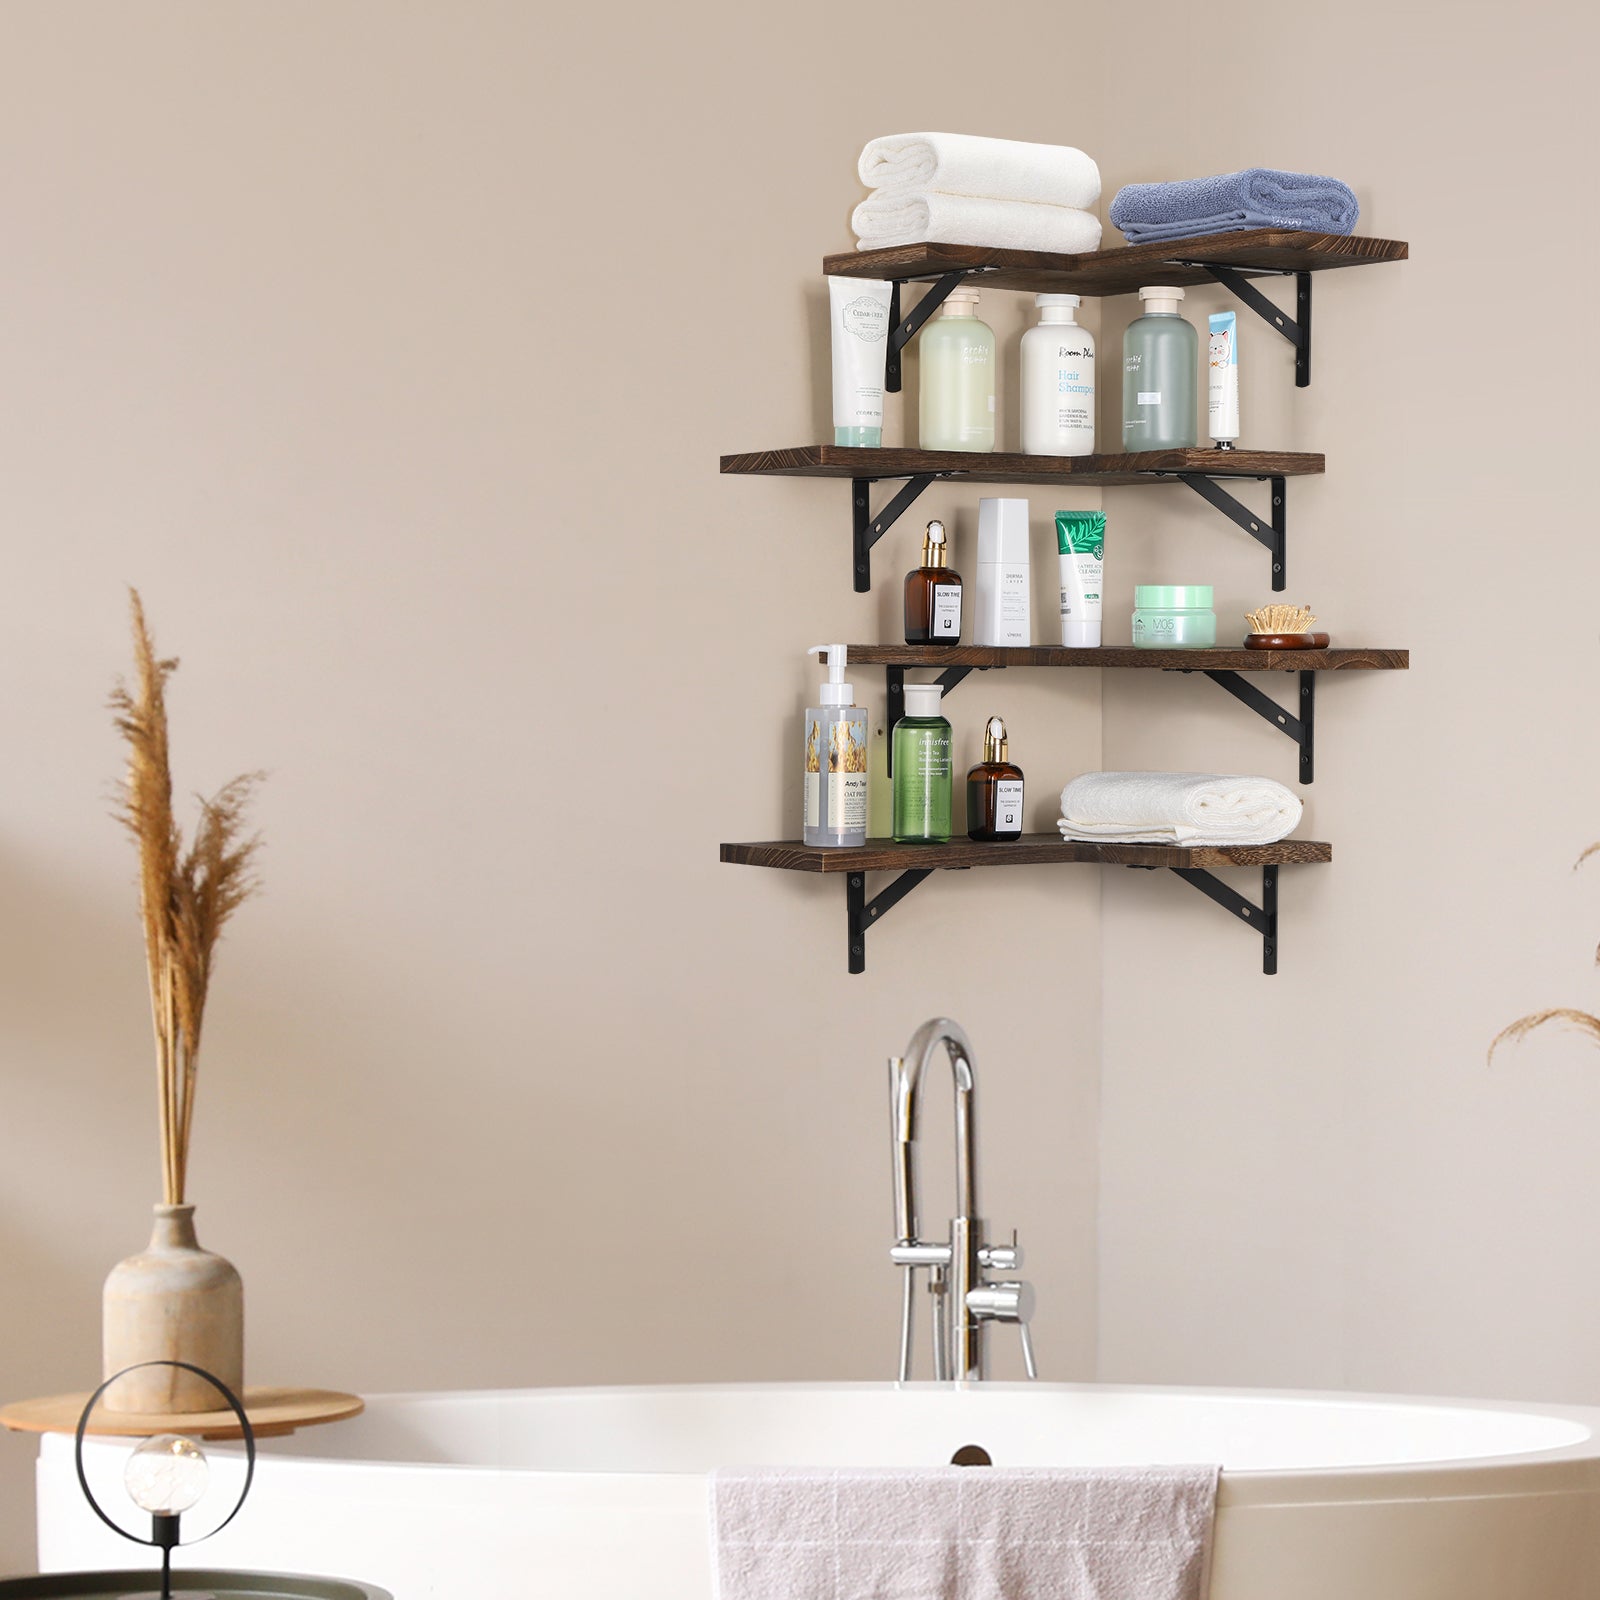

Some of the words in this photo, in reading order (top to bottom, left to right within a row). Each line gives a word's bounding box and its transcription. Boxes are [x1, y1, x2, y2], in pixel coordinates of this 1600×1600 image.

[1059, 346, 1081, 357] Room
[1059, 369, 1079, 380] Hair
[845, 780, 859, 789] Andy
